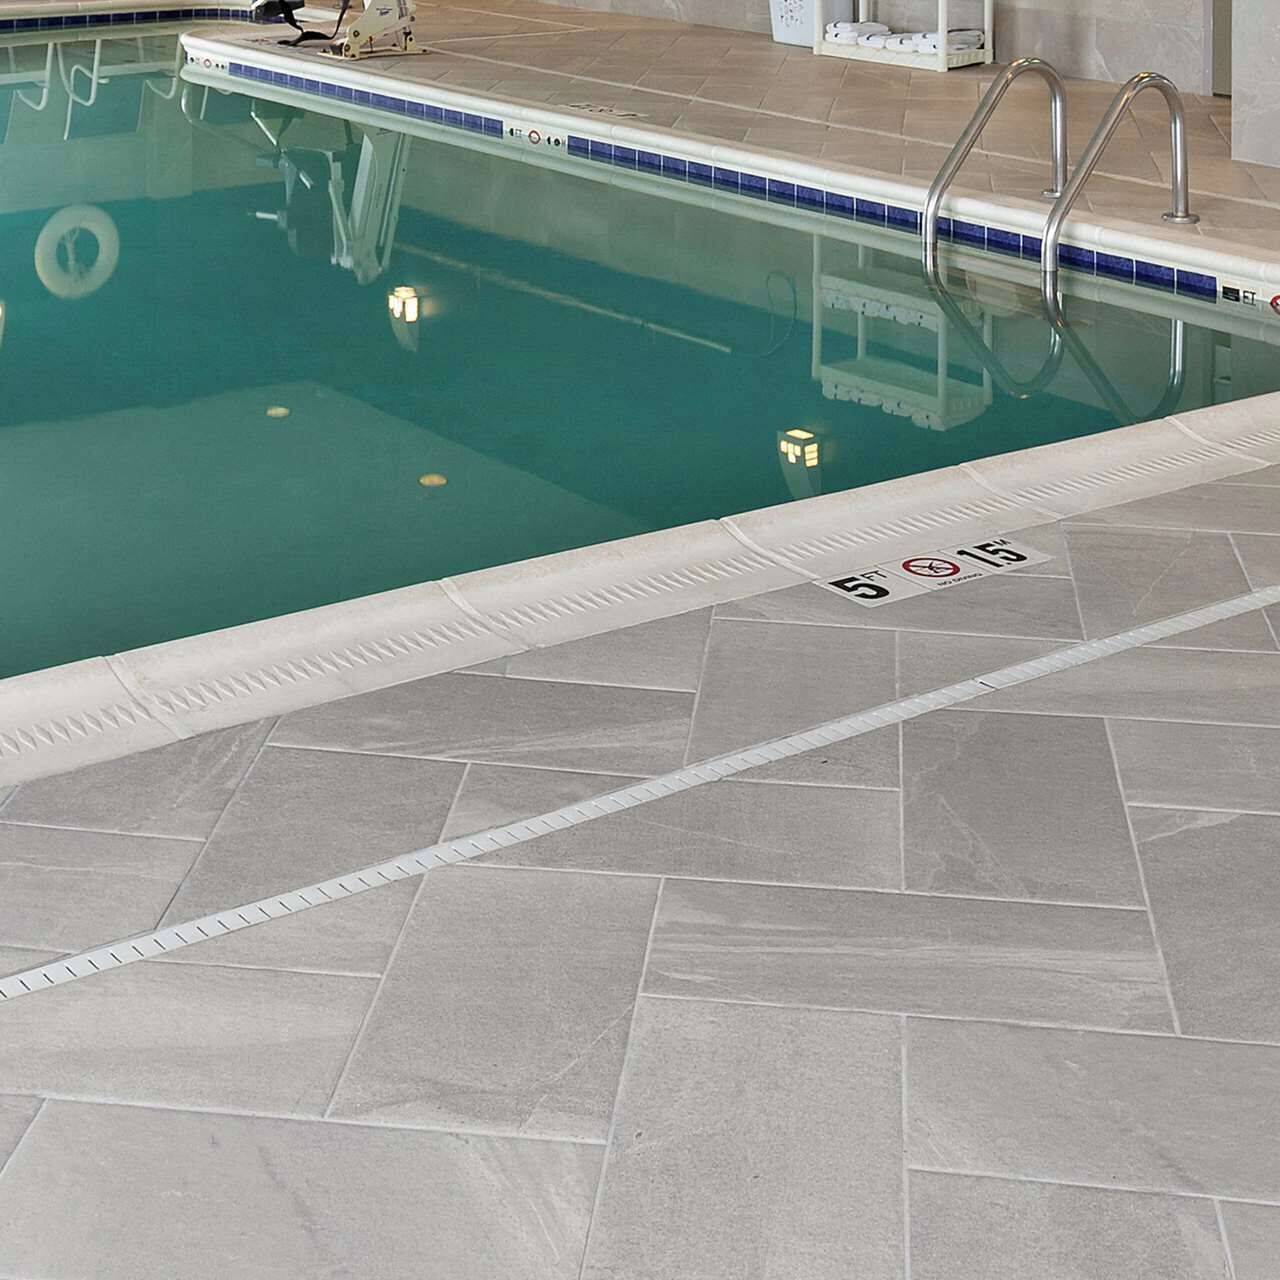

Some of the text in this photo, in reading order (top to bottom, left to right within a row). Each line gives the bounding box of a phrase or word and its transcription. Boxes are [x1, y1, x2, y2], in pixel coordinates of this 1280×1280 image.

[956, 538, 1028, 569] 1.5 M
[829, 569, 890, 600] 5 FT
[952, 573, 984, 583] DIVING
